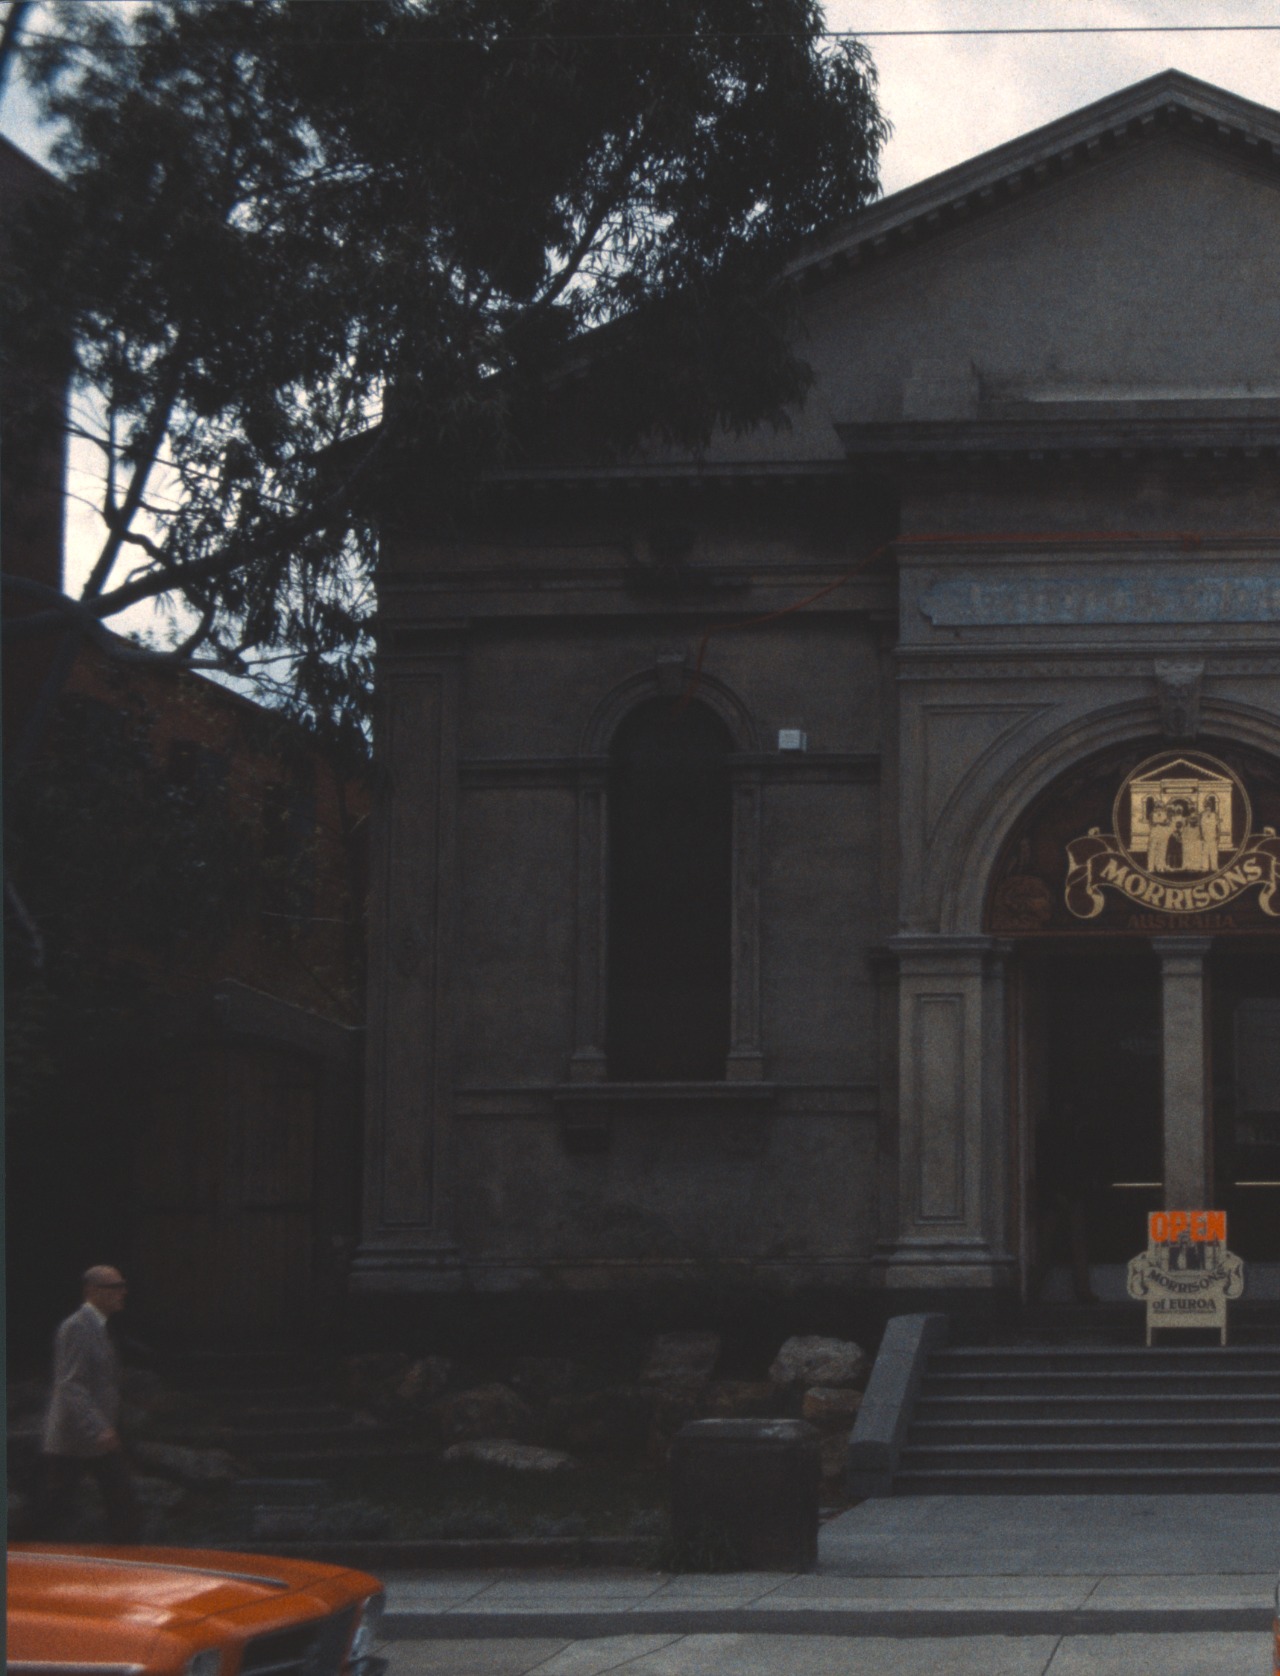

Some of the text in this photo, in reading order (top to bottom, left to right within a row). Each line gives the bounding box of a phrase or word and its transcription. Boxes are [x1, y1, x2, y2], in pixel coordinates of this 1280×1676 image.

[1100, 858, 1262, 909] MORRISONS
[1129, 914, 1235, 928] AUSTRALIA
[1151, 1211, 1225, 1241] OPEN
[1150, 1265, 1225, 1292] MORRISONS
[1152, 1299, 1217, 1309] of EUROA
